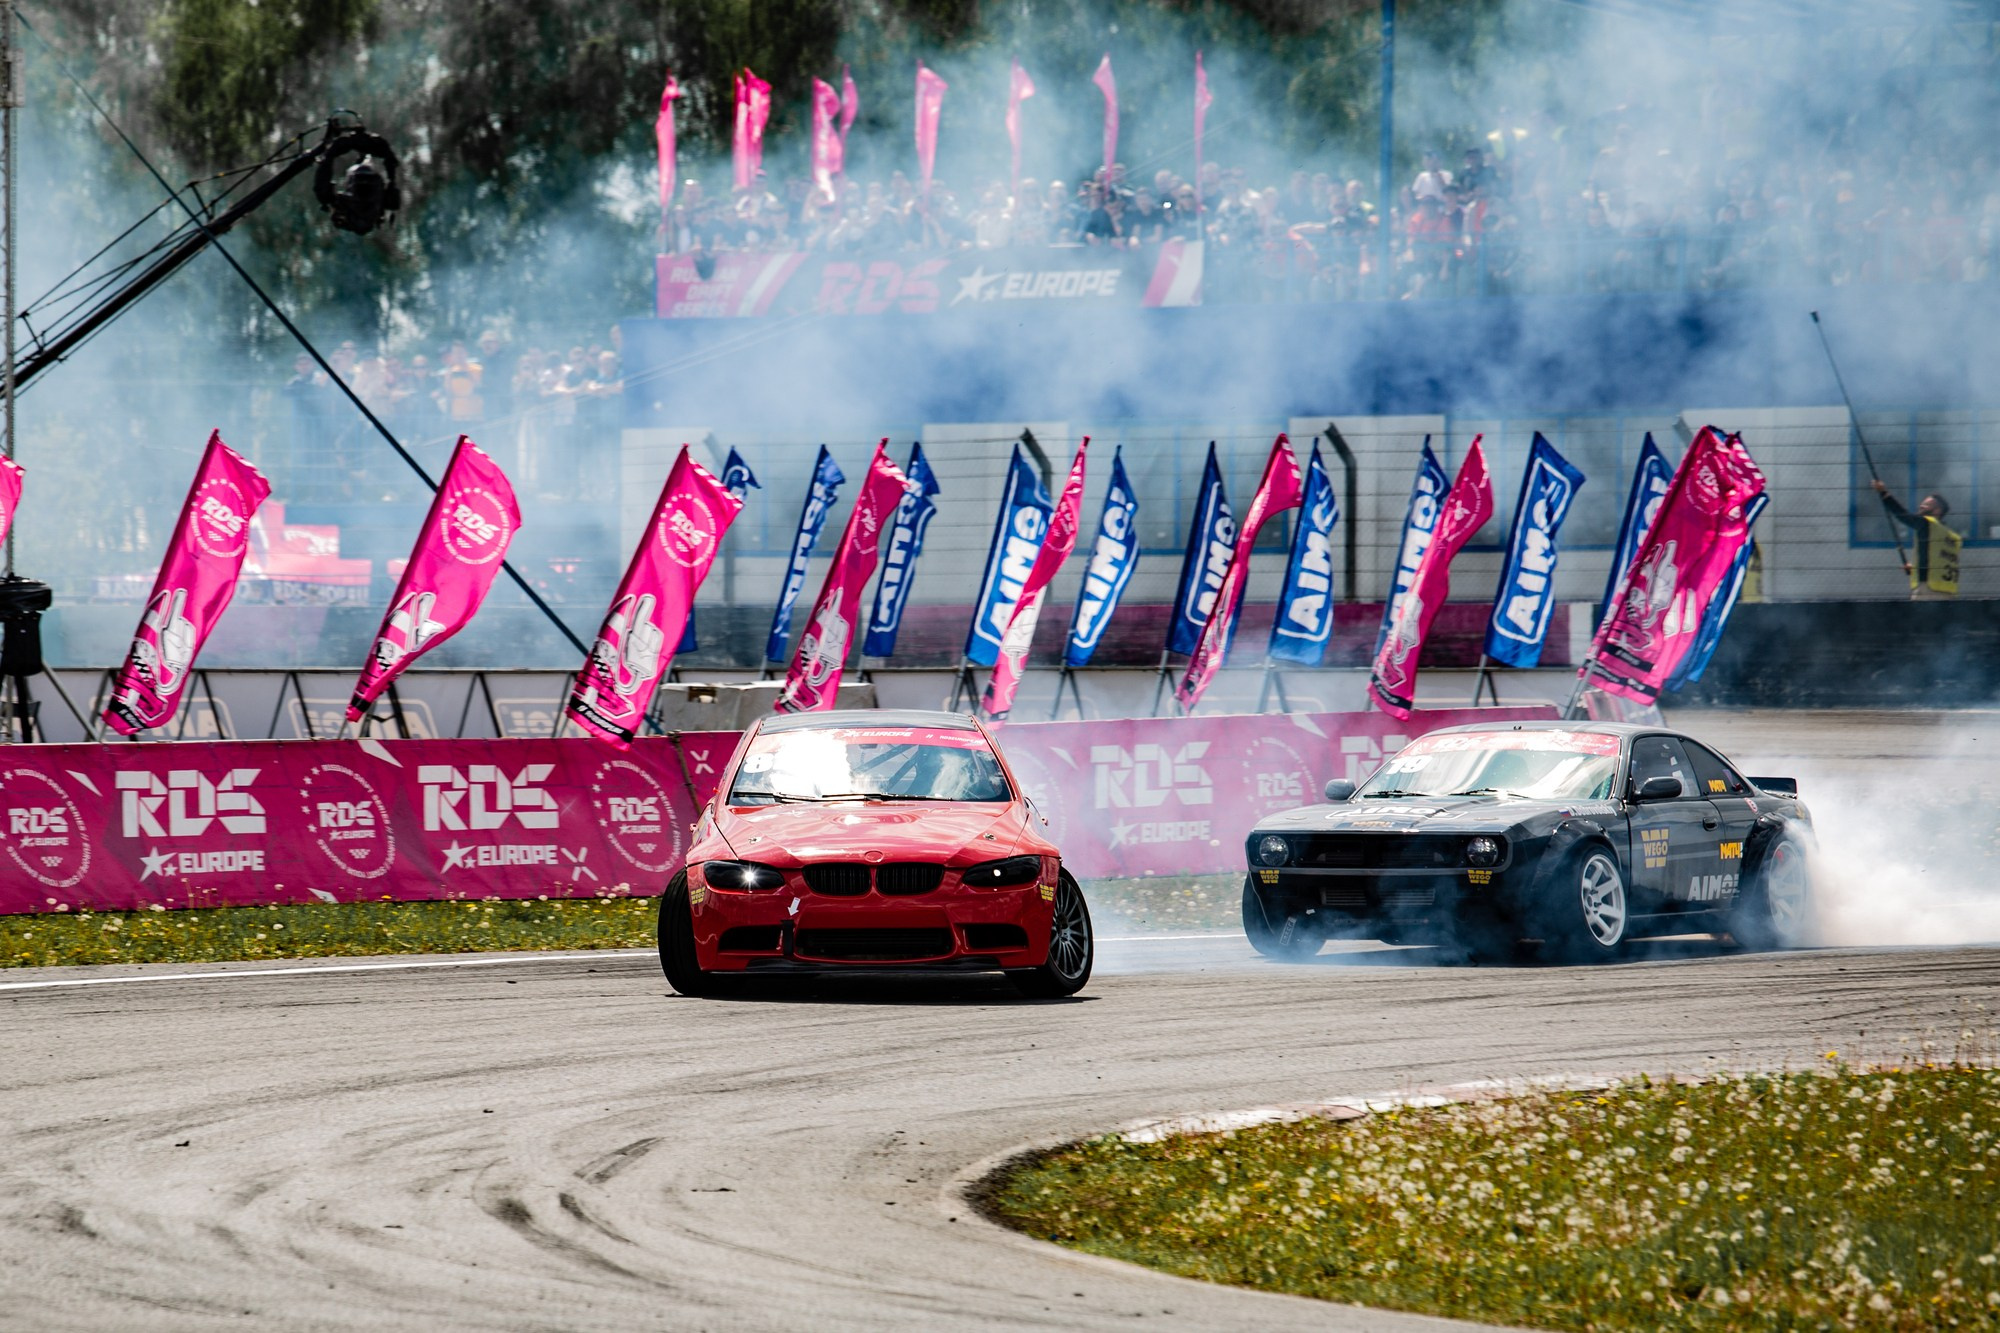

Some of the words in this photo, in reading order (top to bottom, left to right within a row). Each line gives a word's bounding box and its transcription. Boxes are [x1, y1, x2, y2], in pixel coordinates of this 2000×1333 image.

[818, 260, 951, 315] RDS
[1001, 268, 1122, 300] EUROPE
[201, 496, 246, 533] RDS
[453, 504, 501, 540] RDS
[670, 509, 709, 545] RDS
[990, 505, 1055, 637] AIMO
[861, 730, 913, 738] EUROPE
[1090, 742, 1213, 809] RDS
[1386, 755, 1433, 775] 19
[417, 763, 559, 832] RDS
[1256, 771, 1304, 797] RDS
[115, 768, 267, 838] RDS
[317, 801, 375, 828] RDS
[608, 796, 661, 821] RDS
[8, 807, 69, 834] RDS
[1141, 820, 1210, 843] EUROPE
[179, 849, 265, 875] EUROPE
[478, 843, 559, 867] EUROPE
[1644, 841, 1668, 856] WEGO
